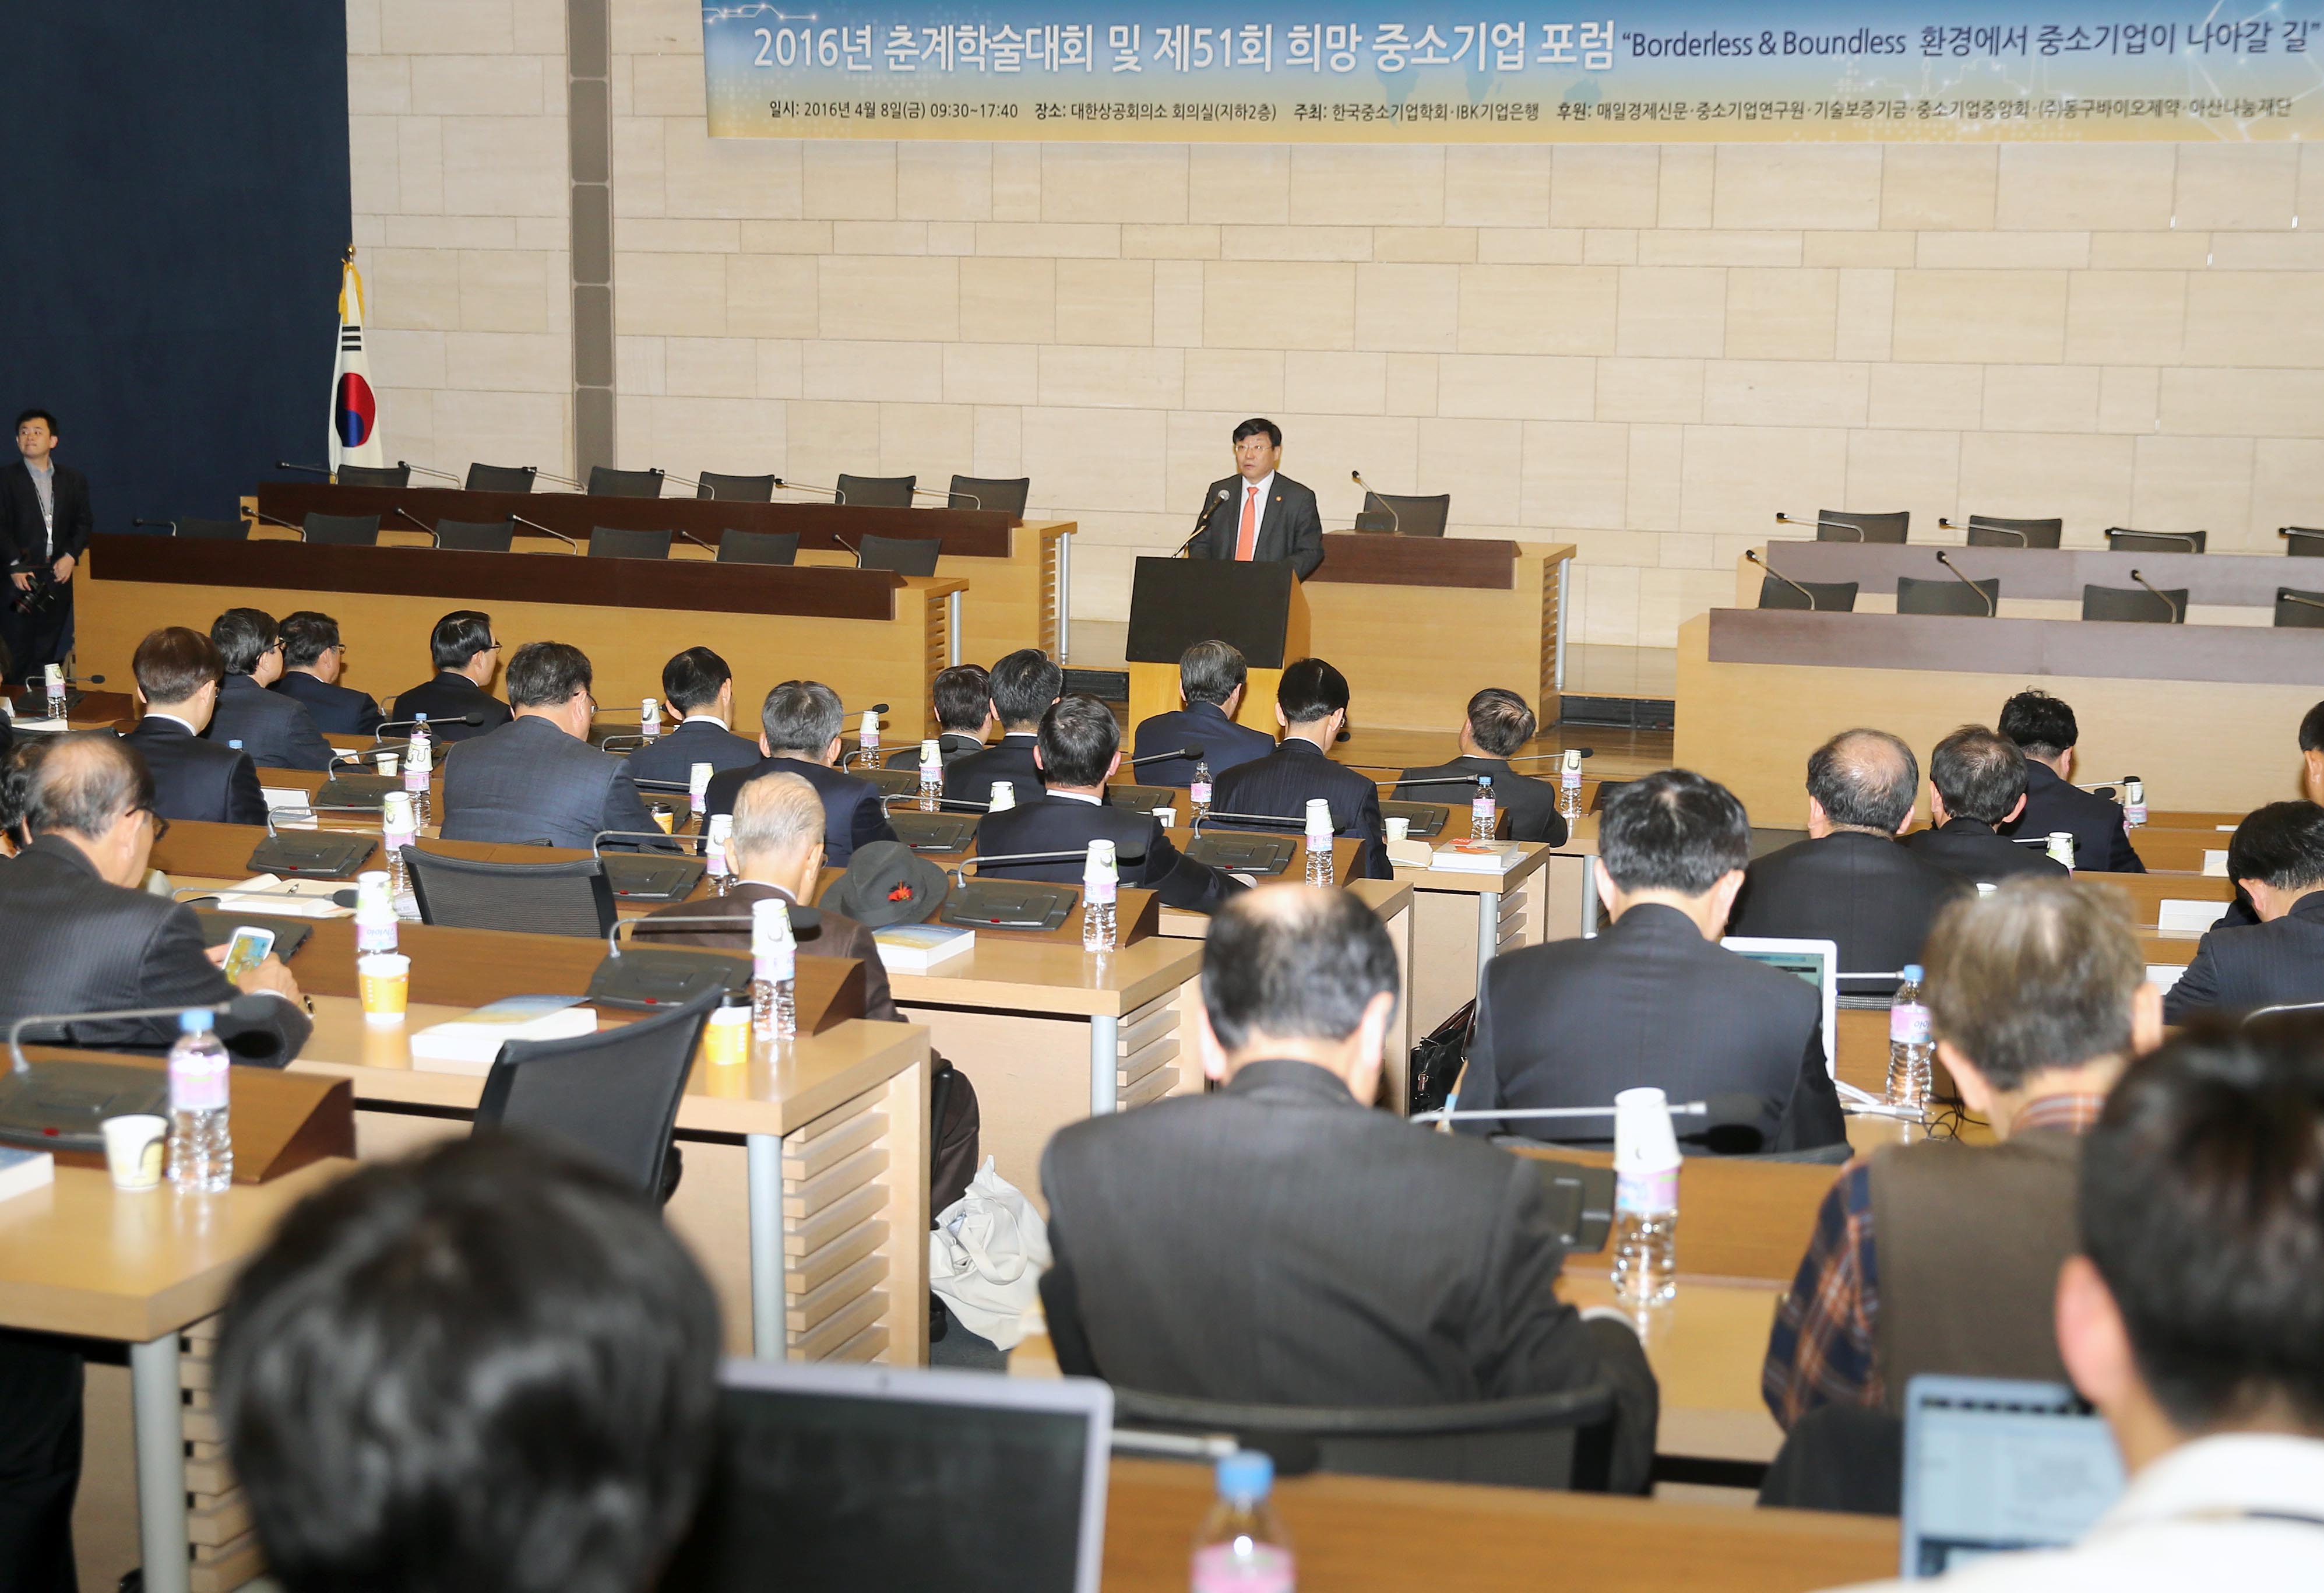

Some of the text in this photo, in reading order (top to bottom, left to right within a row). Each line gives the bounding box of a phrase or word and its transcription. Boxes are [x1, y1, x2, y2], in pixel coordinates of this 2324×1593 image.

[754, 20, 1614, 72] 2016년 춘계학술대회 및 제51회 희망 중소기업 포럼
[1758, 31, 1777, 55] &
[1783, 29, 1906, 55] Boundless
[1920, 25, 2028, 57] 환경에서
[2036, 23, 2175, 55] 중소기업이
[2187, 23, 2271, 53] 나아갈
[769, 100, 799, 118] 일시:
[804, 101, 850, 119] 2016년
[854, 101, 876, 119] 4월
[881, 101, 925, 119] 8일(금)
[931, 103, 1018, 118] 09:30~17:40
[1035, 103, 1066, 120] 장소:
[1072, 103, 1167, 121] 대한상공회의소
[1172, 103, 1276, 121] 회의실(지하2층)
[1294, 103, 1327, 121] 주최:
[1557, 102, 1591, 121] 후원:
